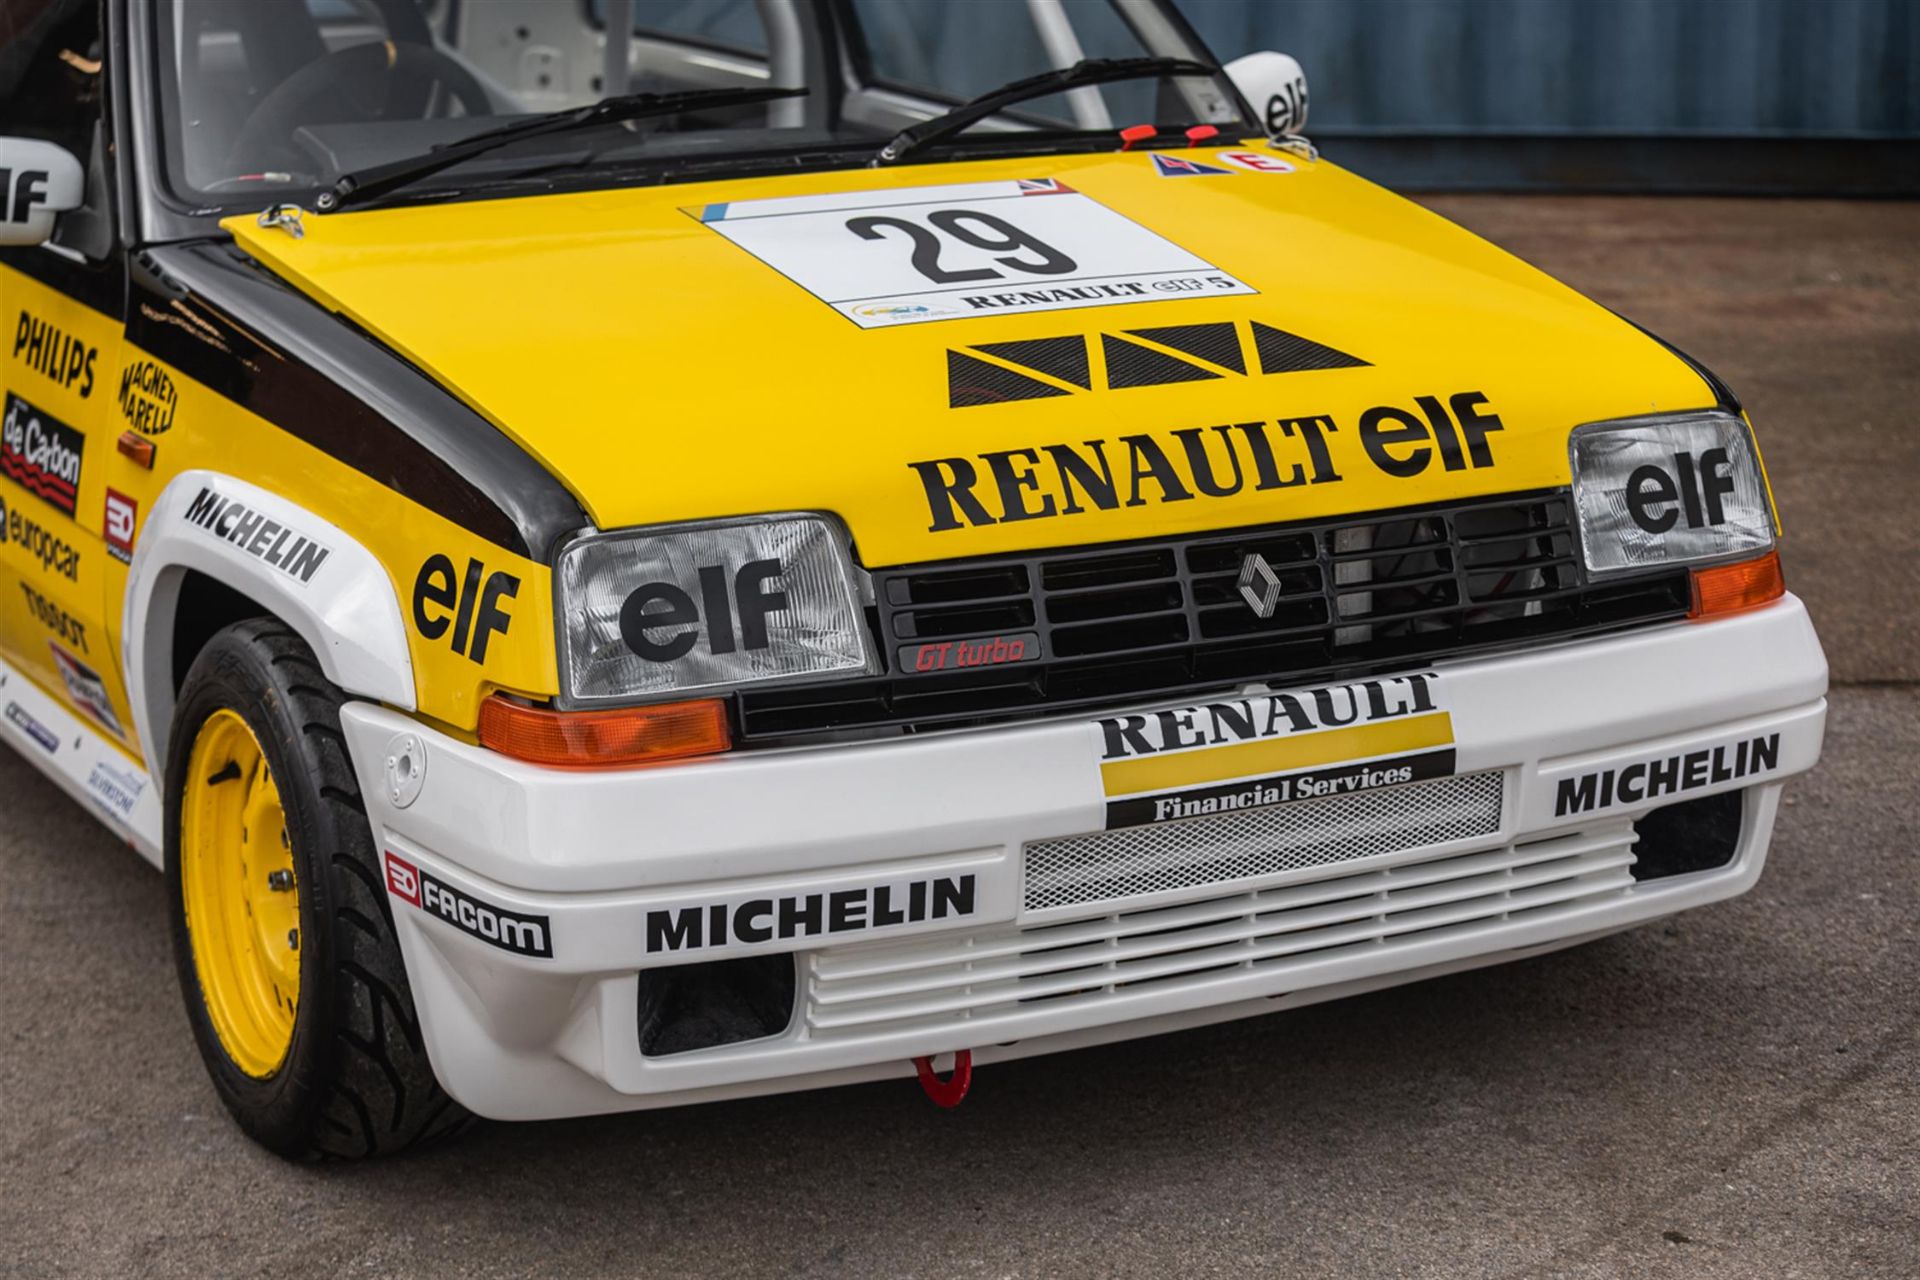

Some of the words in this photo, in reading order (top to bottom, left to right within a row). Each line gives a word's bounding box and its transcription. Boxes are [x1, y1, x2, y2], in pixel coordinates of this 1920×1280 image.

[845, 209, 1078, 284] 29
[959, 281, 1149, 310] RENAULT
[1206, 276, 1236, 290] 5
[13, 310, 98, 399] PHILIPS
[4, 405, 24, 456] de
[25, 418, 80, 485] Carbon
[907, 415, 1343, 533] RENAULT
[1357, 391, 1505, 478] elf
[1625, 447, 1735, 535] elf
[10, 508, 80, 582] europcar
[184, 487, 330, 583] MICHELIN
[412, 553, 521, 666] elf
[619, 558, 789, 662] elf
[915, 642, 954, 672] GT
[956, 636, 1025, 667] turbo
[1099, 672, 1439, 760] RENAULT
[1153, 780, 1290, 822] Financial
[1296, 765, 1412, 800] Services
[1555, 733, 1780, 817] MICHELIN
[646, 874, 976, 953] MICHELIN
